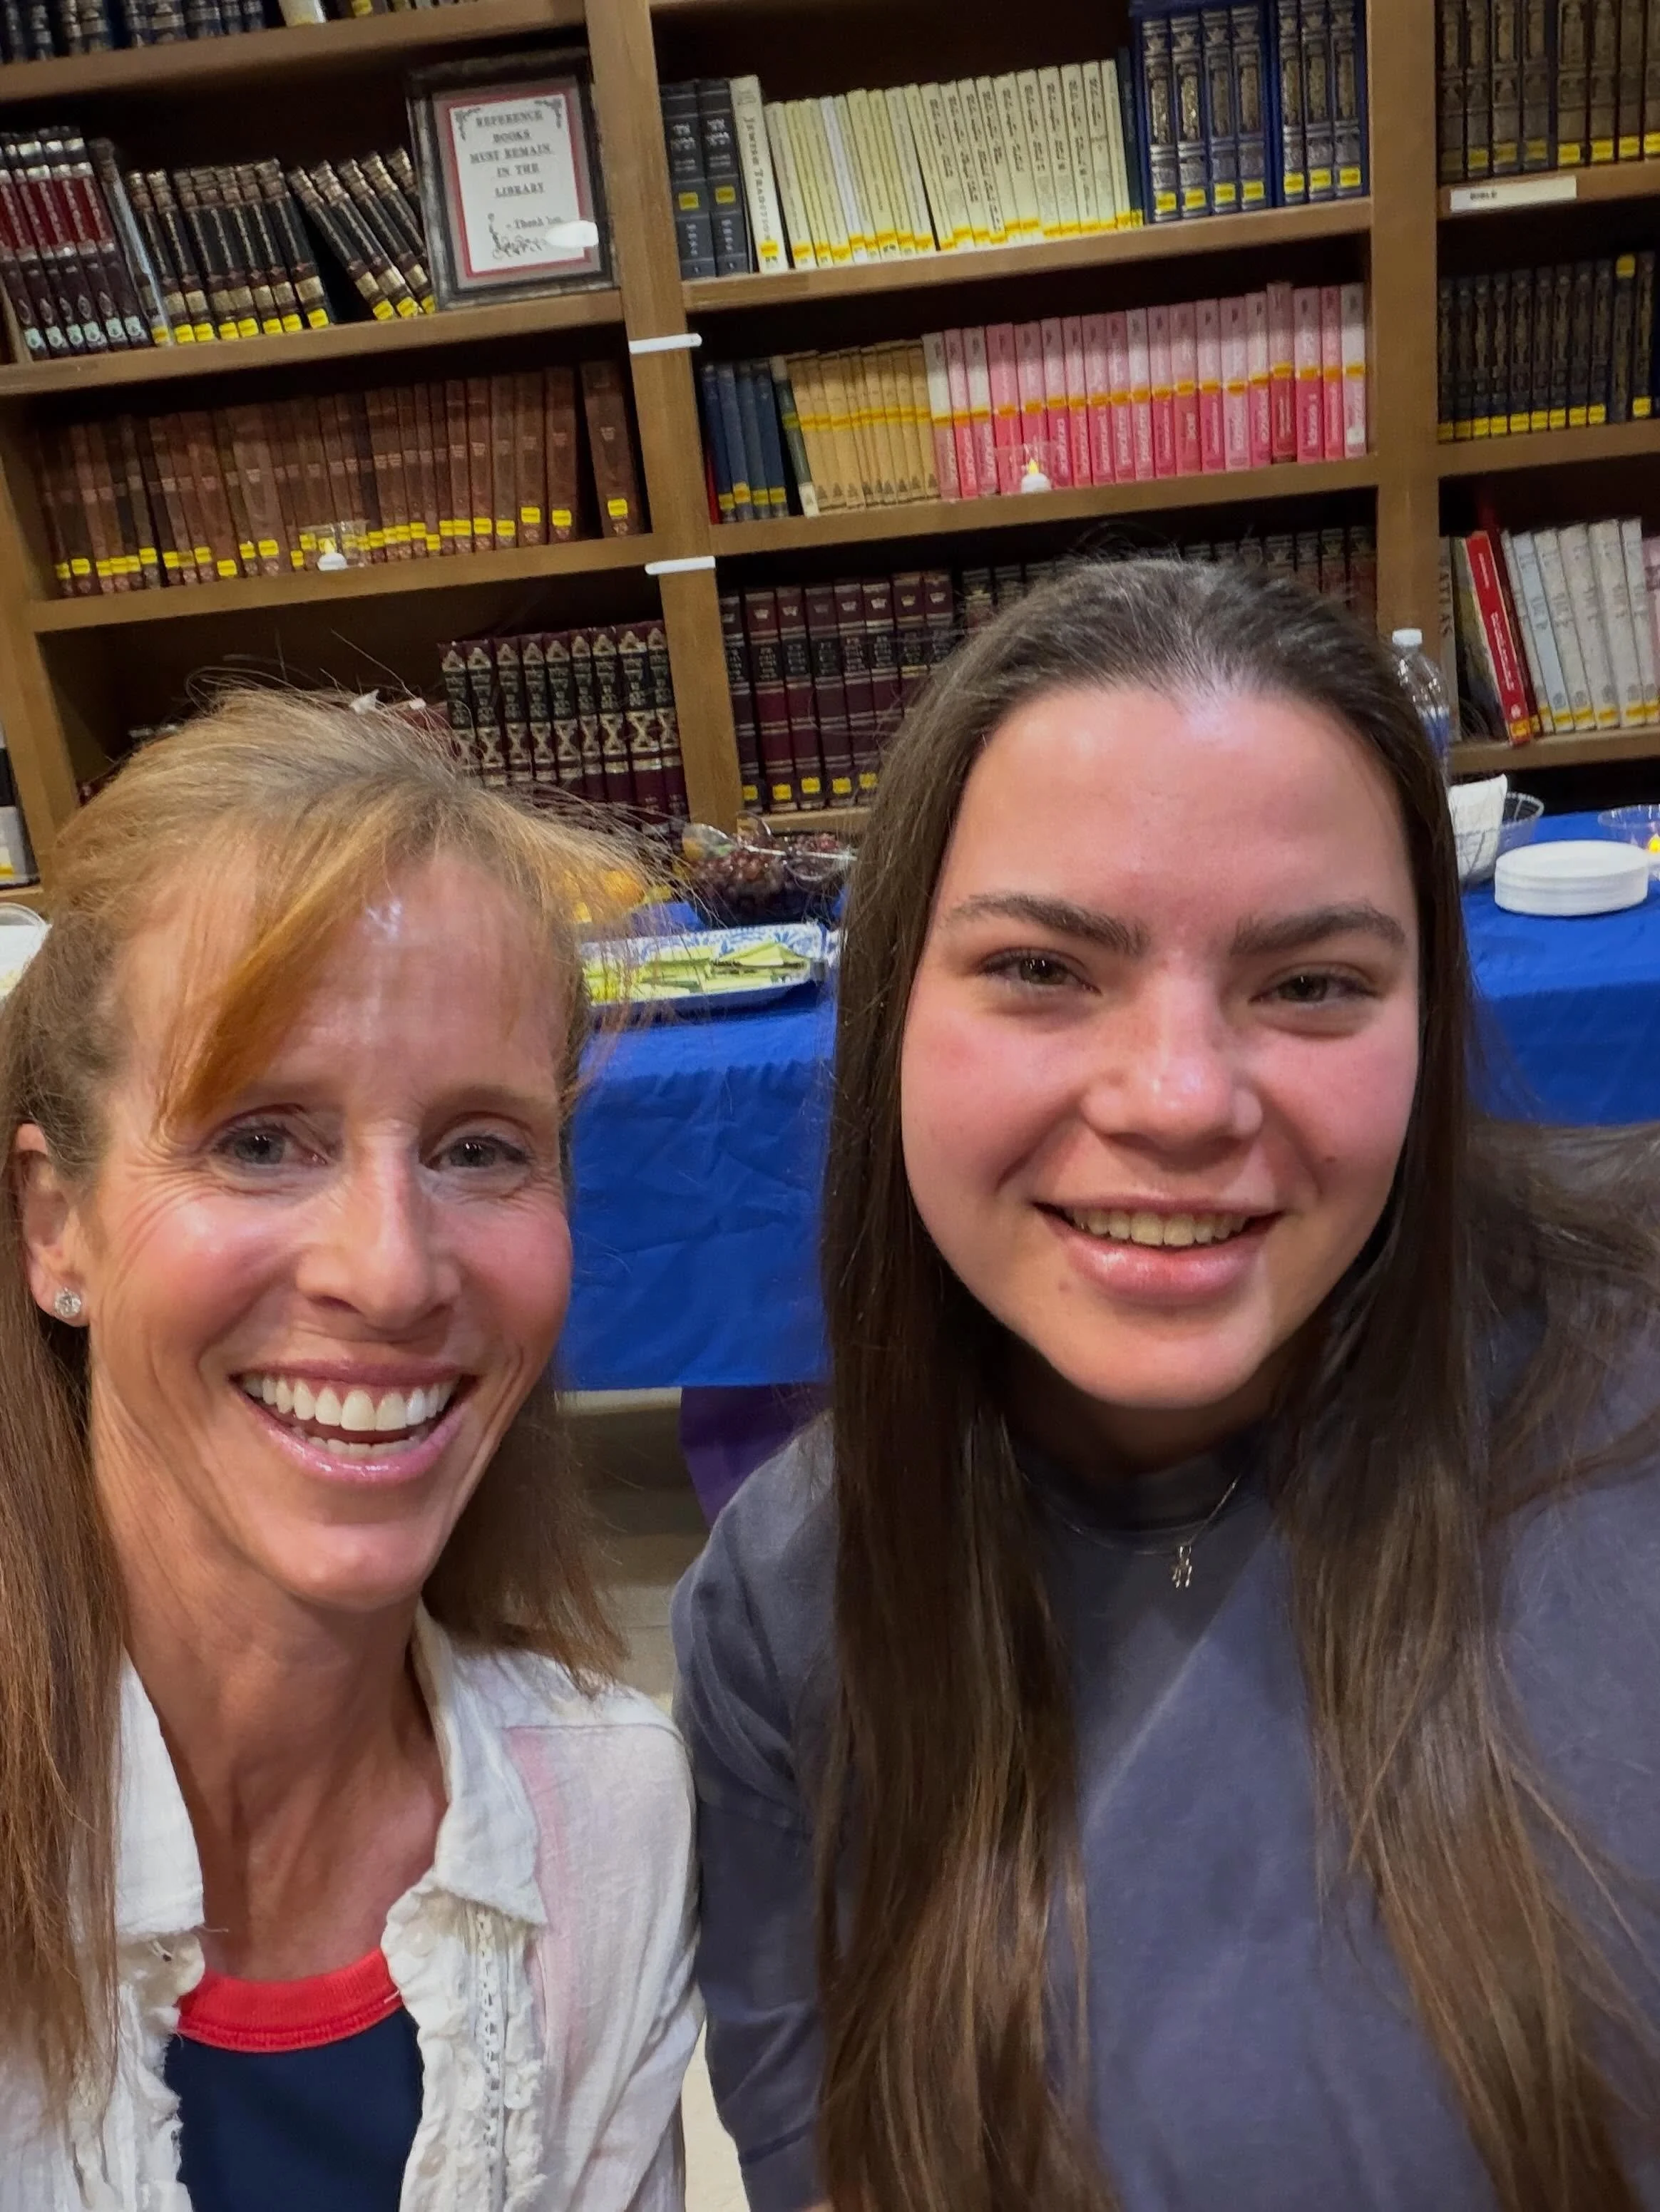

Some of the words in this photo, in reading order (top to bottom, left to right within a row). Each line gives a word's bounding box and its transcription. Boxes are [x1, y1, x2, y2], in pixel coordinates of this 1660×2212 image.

[476, 110, 543, 128] REFERENCE
[493, 129, 531, 143] BOOKS
[469, 149, 500, 164] MUST
[497, 167, 510, 178] IN
[514, 163, 540, 175] THE
[495, 182, 544, 198] LIBRARY
